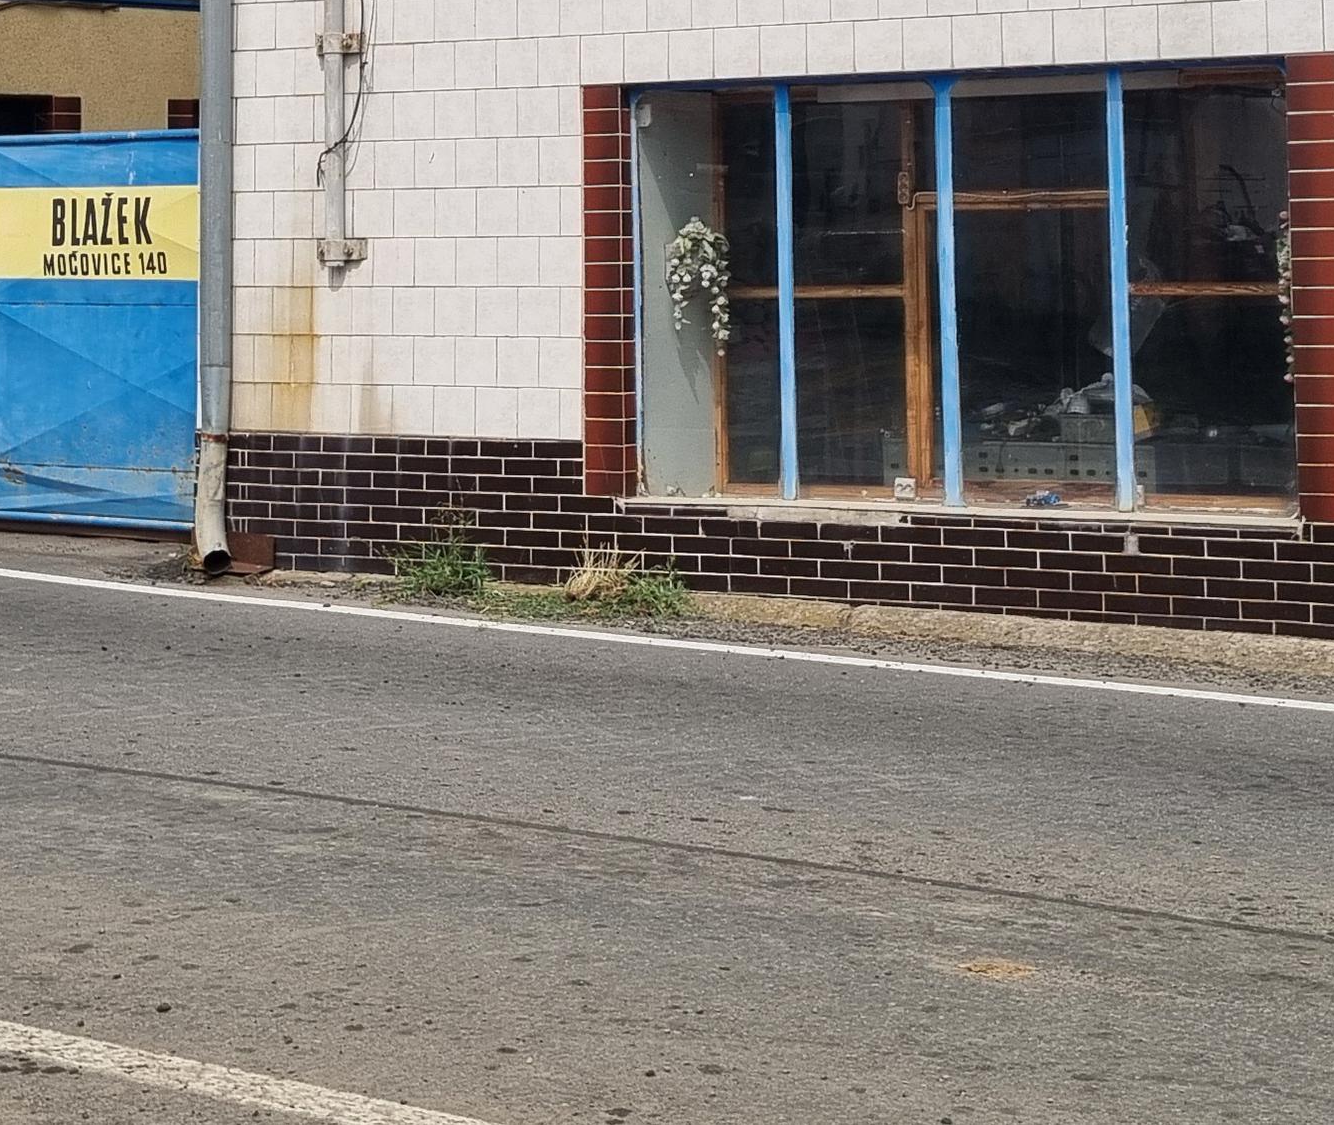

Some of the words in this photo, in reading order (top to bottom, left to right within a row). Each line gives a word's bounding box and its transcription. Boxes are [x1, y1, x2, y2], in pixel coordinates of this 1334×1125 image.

[51, 192, 153, 246] BLAŽEK
[43, 251, 131, 276] MOČOVICE
[138, 251, 168, 275] 140
